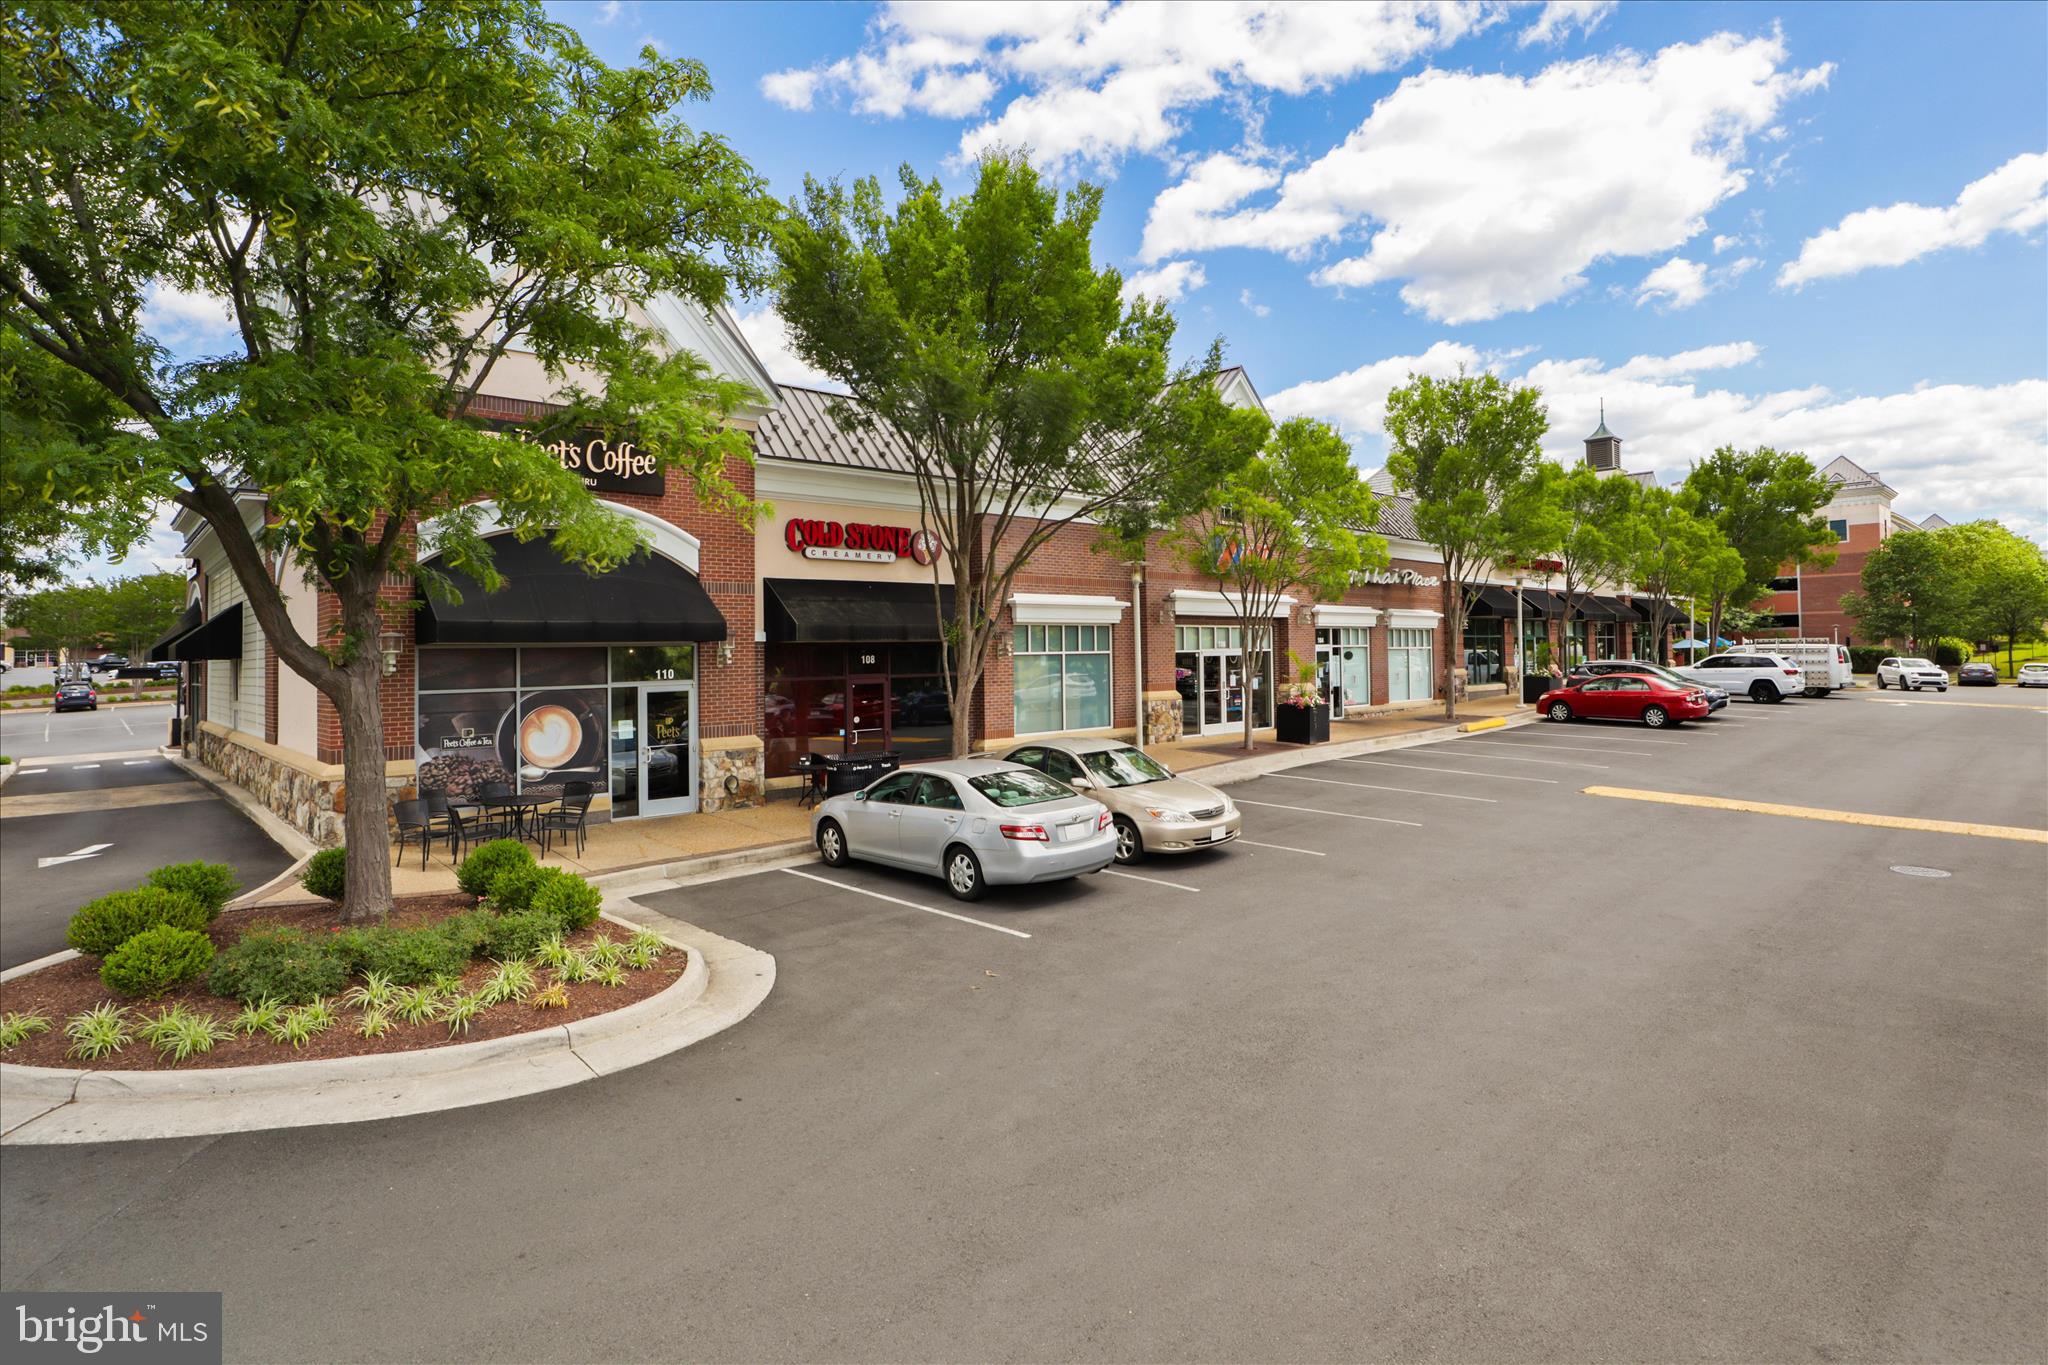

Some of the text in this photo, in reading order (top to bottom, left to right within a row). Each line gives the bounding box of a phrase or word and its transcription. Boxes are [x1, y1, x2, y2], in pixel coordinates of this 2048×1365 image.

[586, 439, 657, 479] Coffee
[785, 518, 912, 557] COLD STONE
[810, 549, 893, 560] CREAMERY
[1401, 569, 1440, 587] Place
[861, 655, 875, 664] 108
[656, 669, 674, 680] 110
[459, 738, 477, 747] Coffee
[482, 737, 493, 745] Tea
